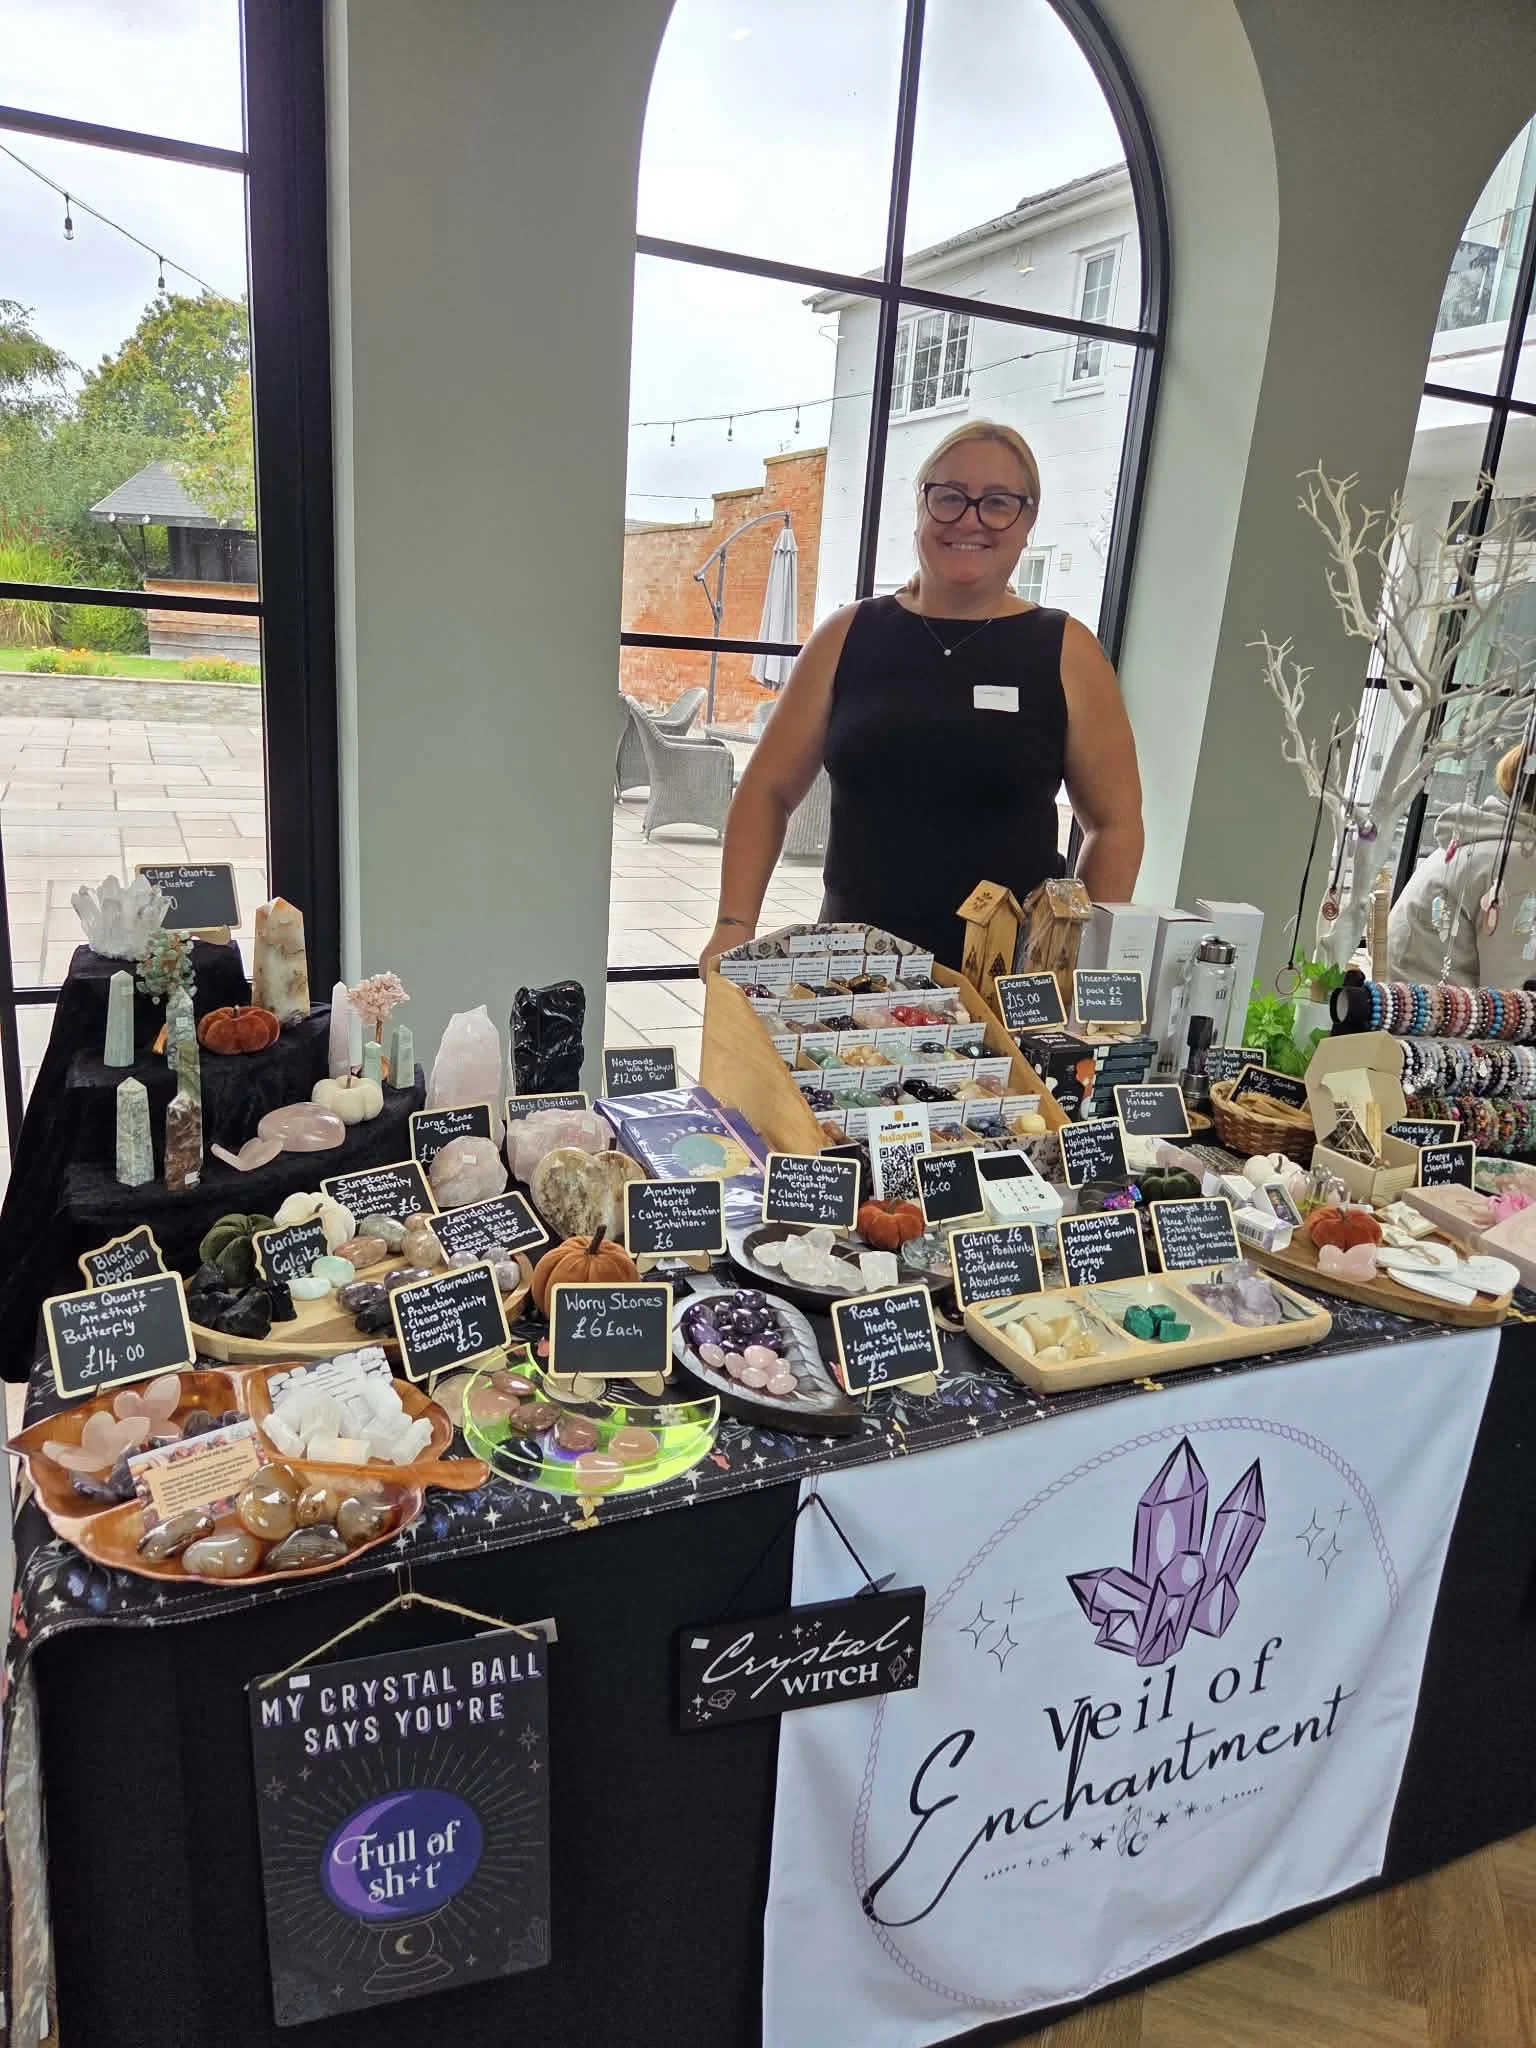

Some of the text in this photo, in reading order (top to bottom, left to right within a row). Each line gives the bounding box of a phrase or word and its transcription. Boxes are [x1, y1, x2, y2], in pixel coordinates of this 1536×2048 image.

[146, 866, 216, 880] Clear Quartz
[159, 880, 195, 889] Cluster
[1109, 986, 1123, 996] £2
[1109, 996, 1122, 1006] £5
[611, 1057, 654, 1068] Notepads
[648, 1071, 665, 1080] Pen
[1127, 1089, 1165, 1098] Incense
[511, 1097, 579, 1112] Black Obsidian
[416, 1112, 474, 1132] Large Rose
[438, 1122, 472, 1134] Quartz
[781, 1158, 852, 1175] Clear Quartz
[335, 1178, 412, 1201] Joy Positivity
[337, 1172, 398, 1191] Sunstone
[642, 1184, 697, 1198] Amethyst
[398, 1195, 421, 1216] £6
[653, 1197, 689, 1208] Hearts
[778, 1188, 843, 1202] Clarity Focus
[442, 1208, 516, 1237] Calm Peace
[447, 1201, 505, 1225] Lepidolite
[638, 1205, 718, 1220] Calm Protection
[450, 1217, 519, 1245] Stress Relief
[653, 1218, 700, 1230] Intuition
[1070, 1216, 1120, 1233] Malachite
[653, 1231, 674, 1250] £6
[961, 1227, 1023, 1248] Citrine £6
[92, 1243, 134, 1270] Black
[272, 1246, 323, 1274] Calcite
[963, 1241, 1035, 1264] Joy Positivity
[1069, 1243, 1113, 1257] Confidence
[96, 1249, 150, 1286] Obsidian
[965, 1260, 1018, 1274] Confidence
[1070, 1257, 1105, 1269] Courage
[969, 1273, 1021, 1289] Abundance
[1078, 1267, 1097, 1286] £6
[401, 1271, 489, 1304] Black Tourmaline
[971, 1287, 1013, 1300] Success
[60, 1301, 98, 1317] Rose
[101, 1288, 147, 1306] Quartz
[80, 1301, 148, 1325] Amethyst
[407, 1296, 456, 1319] Protection
[408, 1295, 487, 1330] Clears negativity
[564, 1292, 663, 1317] Worry Stones
[849, 1297, 921, 1320] Rose Quartz
[62, 1318, 136, 1344] Butterfly
[411, 1318, 462, 1342] Grounding
[456, 1321, 483, 1353] £5
[571, 1316, 643, 1339] £6 Each
[864, 1318, 898, 1337] Hearts
[414, 1332, 455, 1353] Security
[853, 1339, 874, 1353] Love
[903, 1327, 926, 1340] love
[80, 1344, 145, 1378] £14.00
[857, 1345, 898, 1366] Emotional
[868, 1360, 888, 1383] £5
[702, 1615, 911, 1700] Crystal
[261, 1651, 542, 1728] MY CRYSTAL BALL
[780, 1662, 880, 1697] WITCH
[1043, 1636, 1283, 1752] Veil of
[304, 1692, 505, 1756] SAYS YOU'RE
[861, 1683, 1359, 1928] Enchantment
[332, 1819, 462, 1872] Full of
